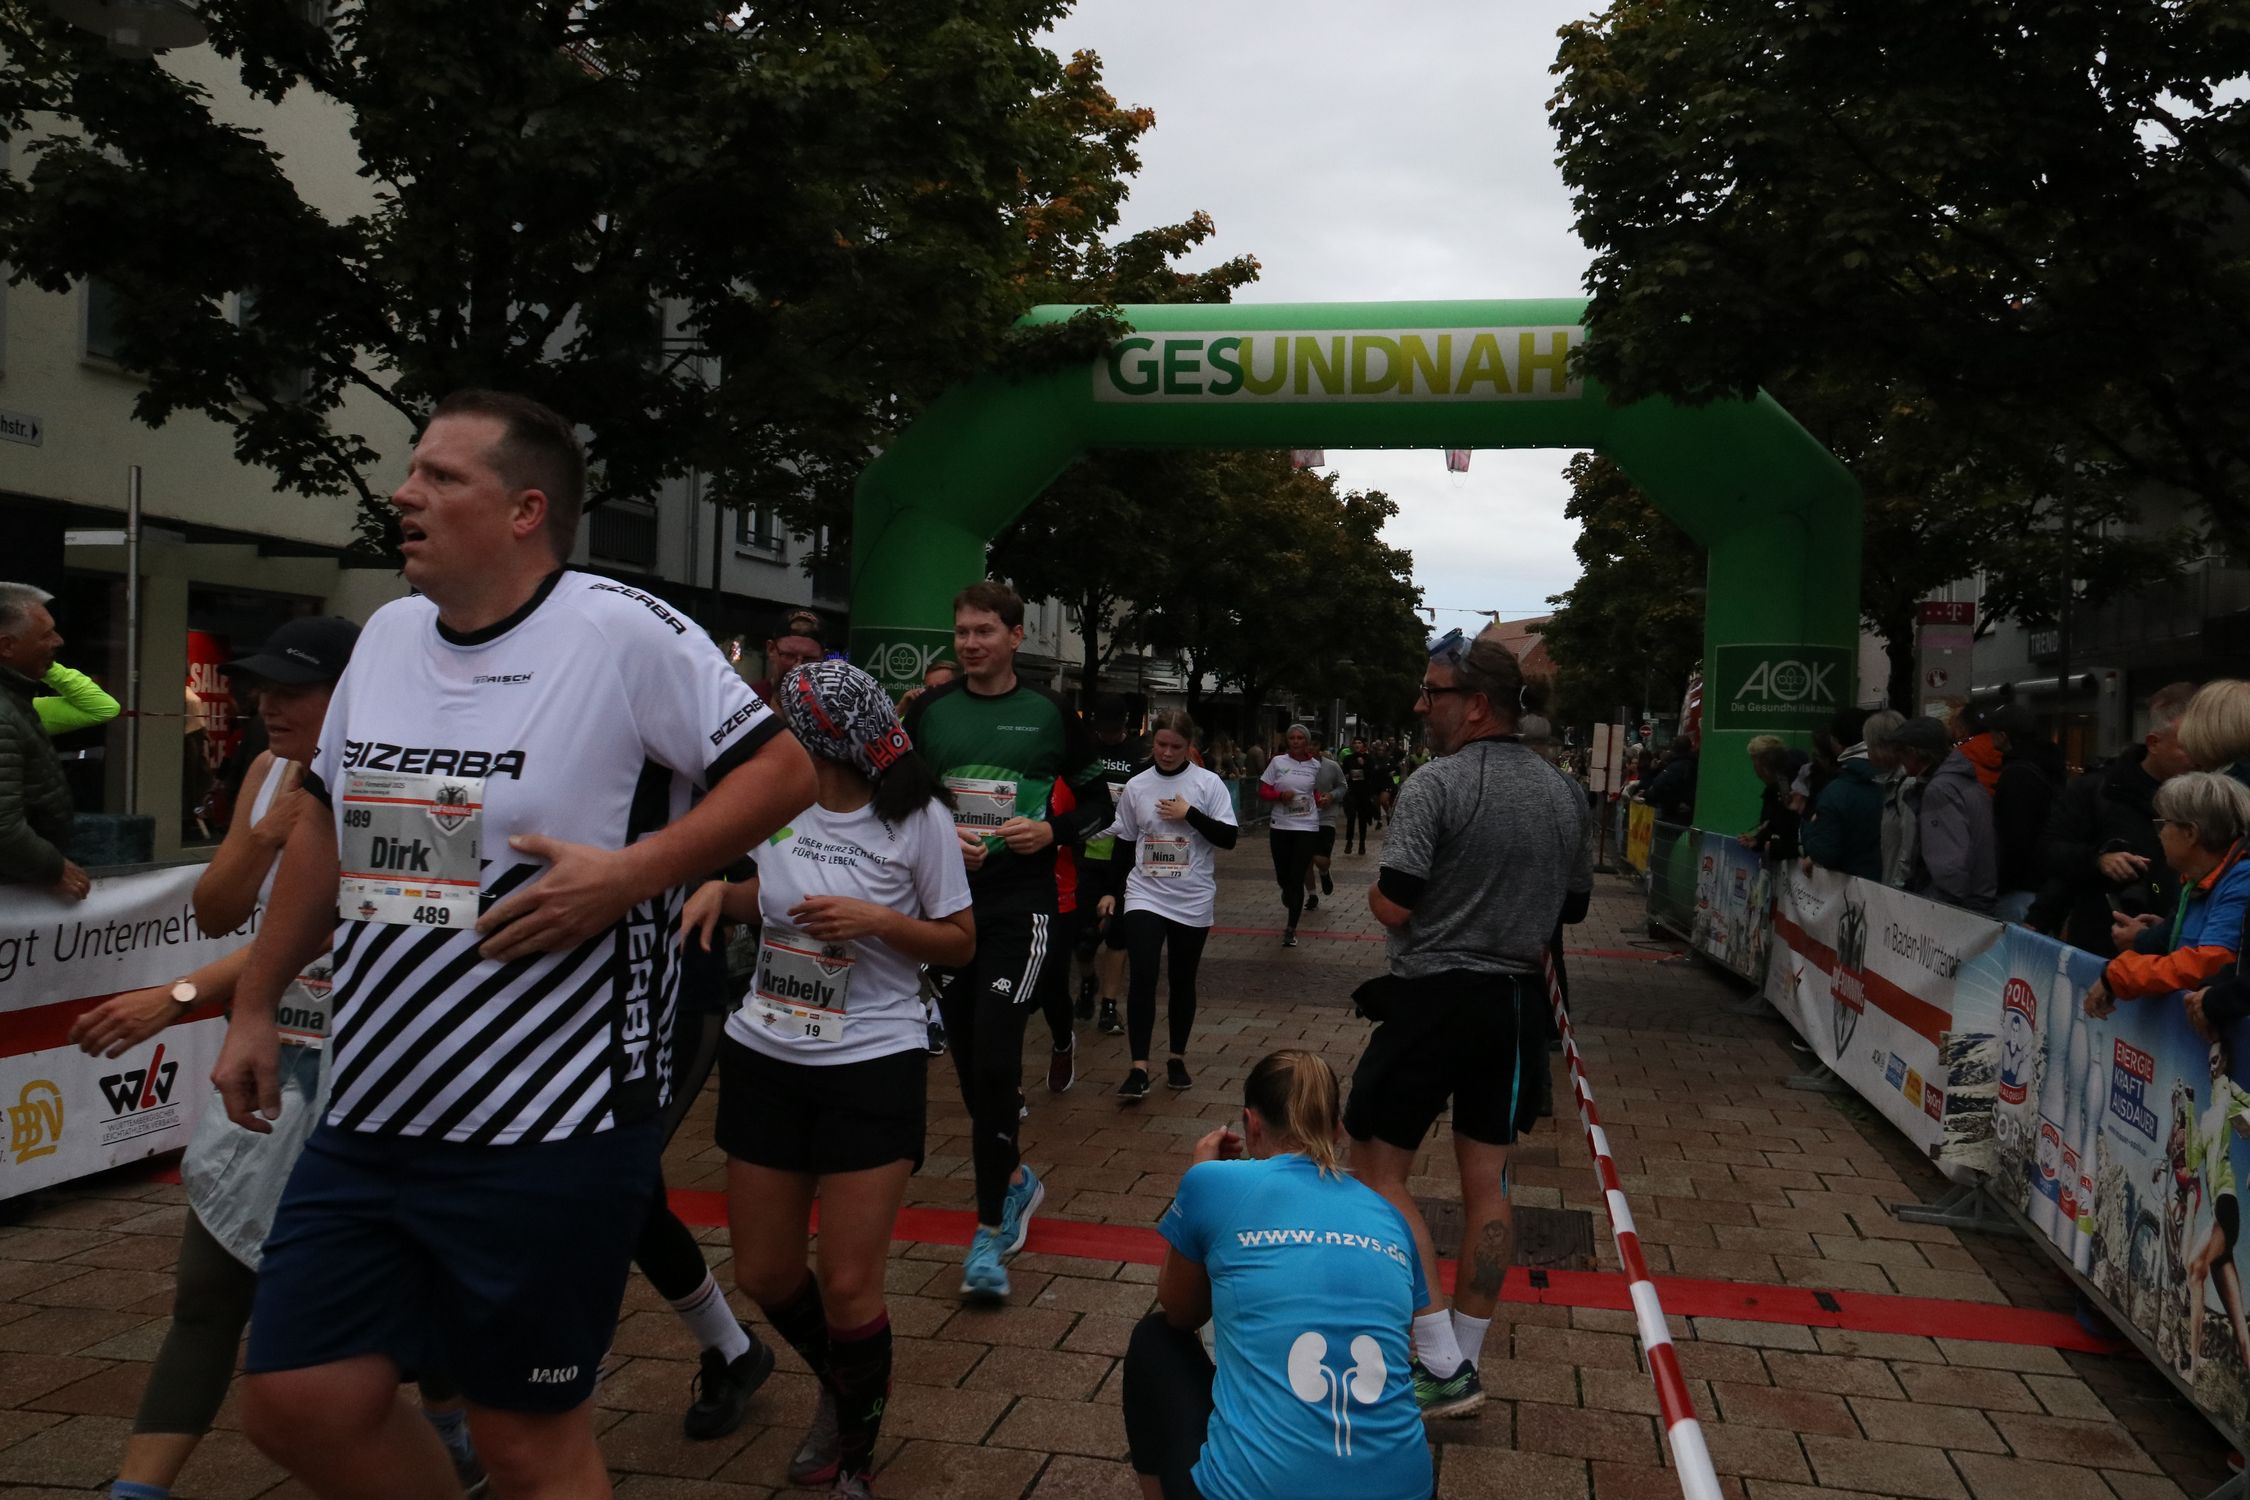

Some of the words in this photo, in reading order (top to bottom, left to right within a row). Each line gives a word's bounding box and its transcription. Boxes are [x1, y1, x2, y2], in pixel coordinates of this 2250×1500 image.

[1107, 331, 1569, 397] GESUNDNAH
[1734, 660, 1838, 702] AOK
[1731, 702, 1745, 712] Die
[343, 739, 525, 780] BIZERBA
[344, 809, 372, 828] 489
[370, 836, 431, 872] Dirk
[828, 856, 858, 867] LEBEN.
[1152, 851, 1175, 862] Nina
[413, 906, 450, 925] 489
[762, 950, 772, 963] 19
[762, 968, 834, 1009] Arabely
[805, 1023, 820, 1037] 19
[2116, 1042, 2152, 1079] ENERGIE
[2113, 1066, 2143, 1099] KRAFT
[2111, 1091, 2155, 1137] AUSDAUER
[1237, 1229, 1407, 1266] www.nzvs.de
[528, 1365, 579, 1383] JAKO
